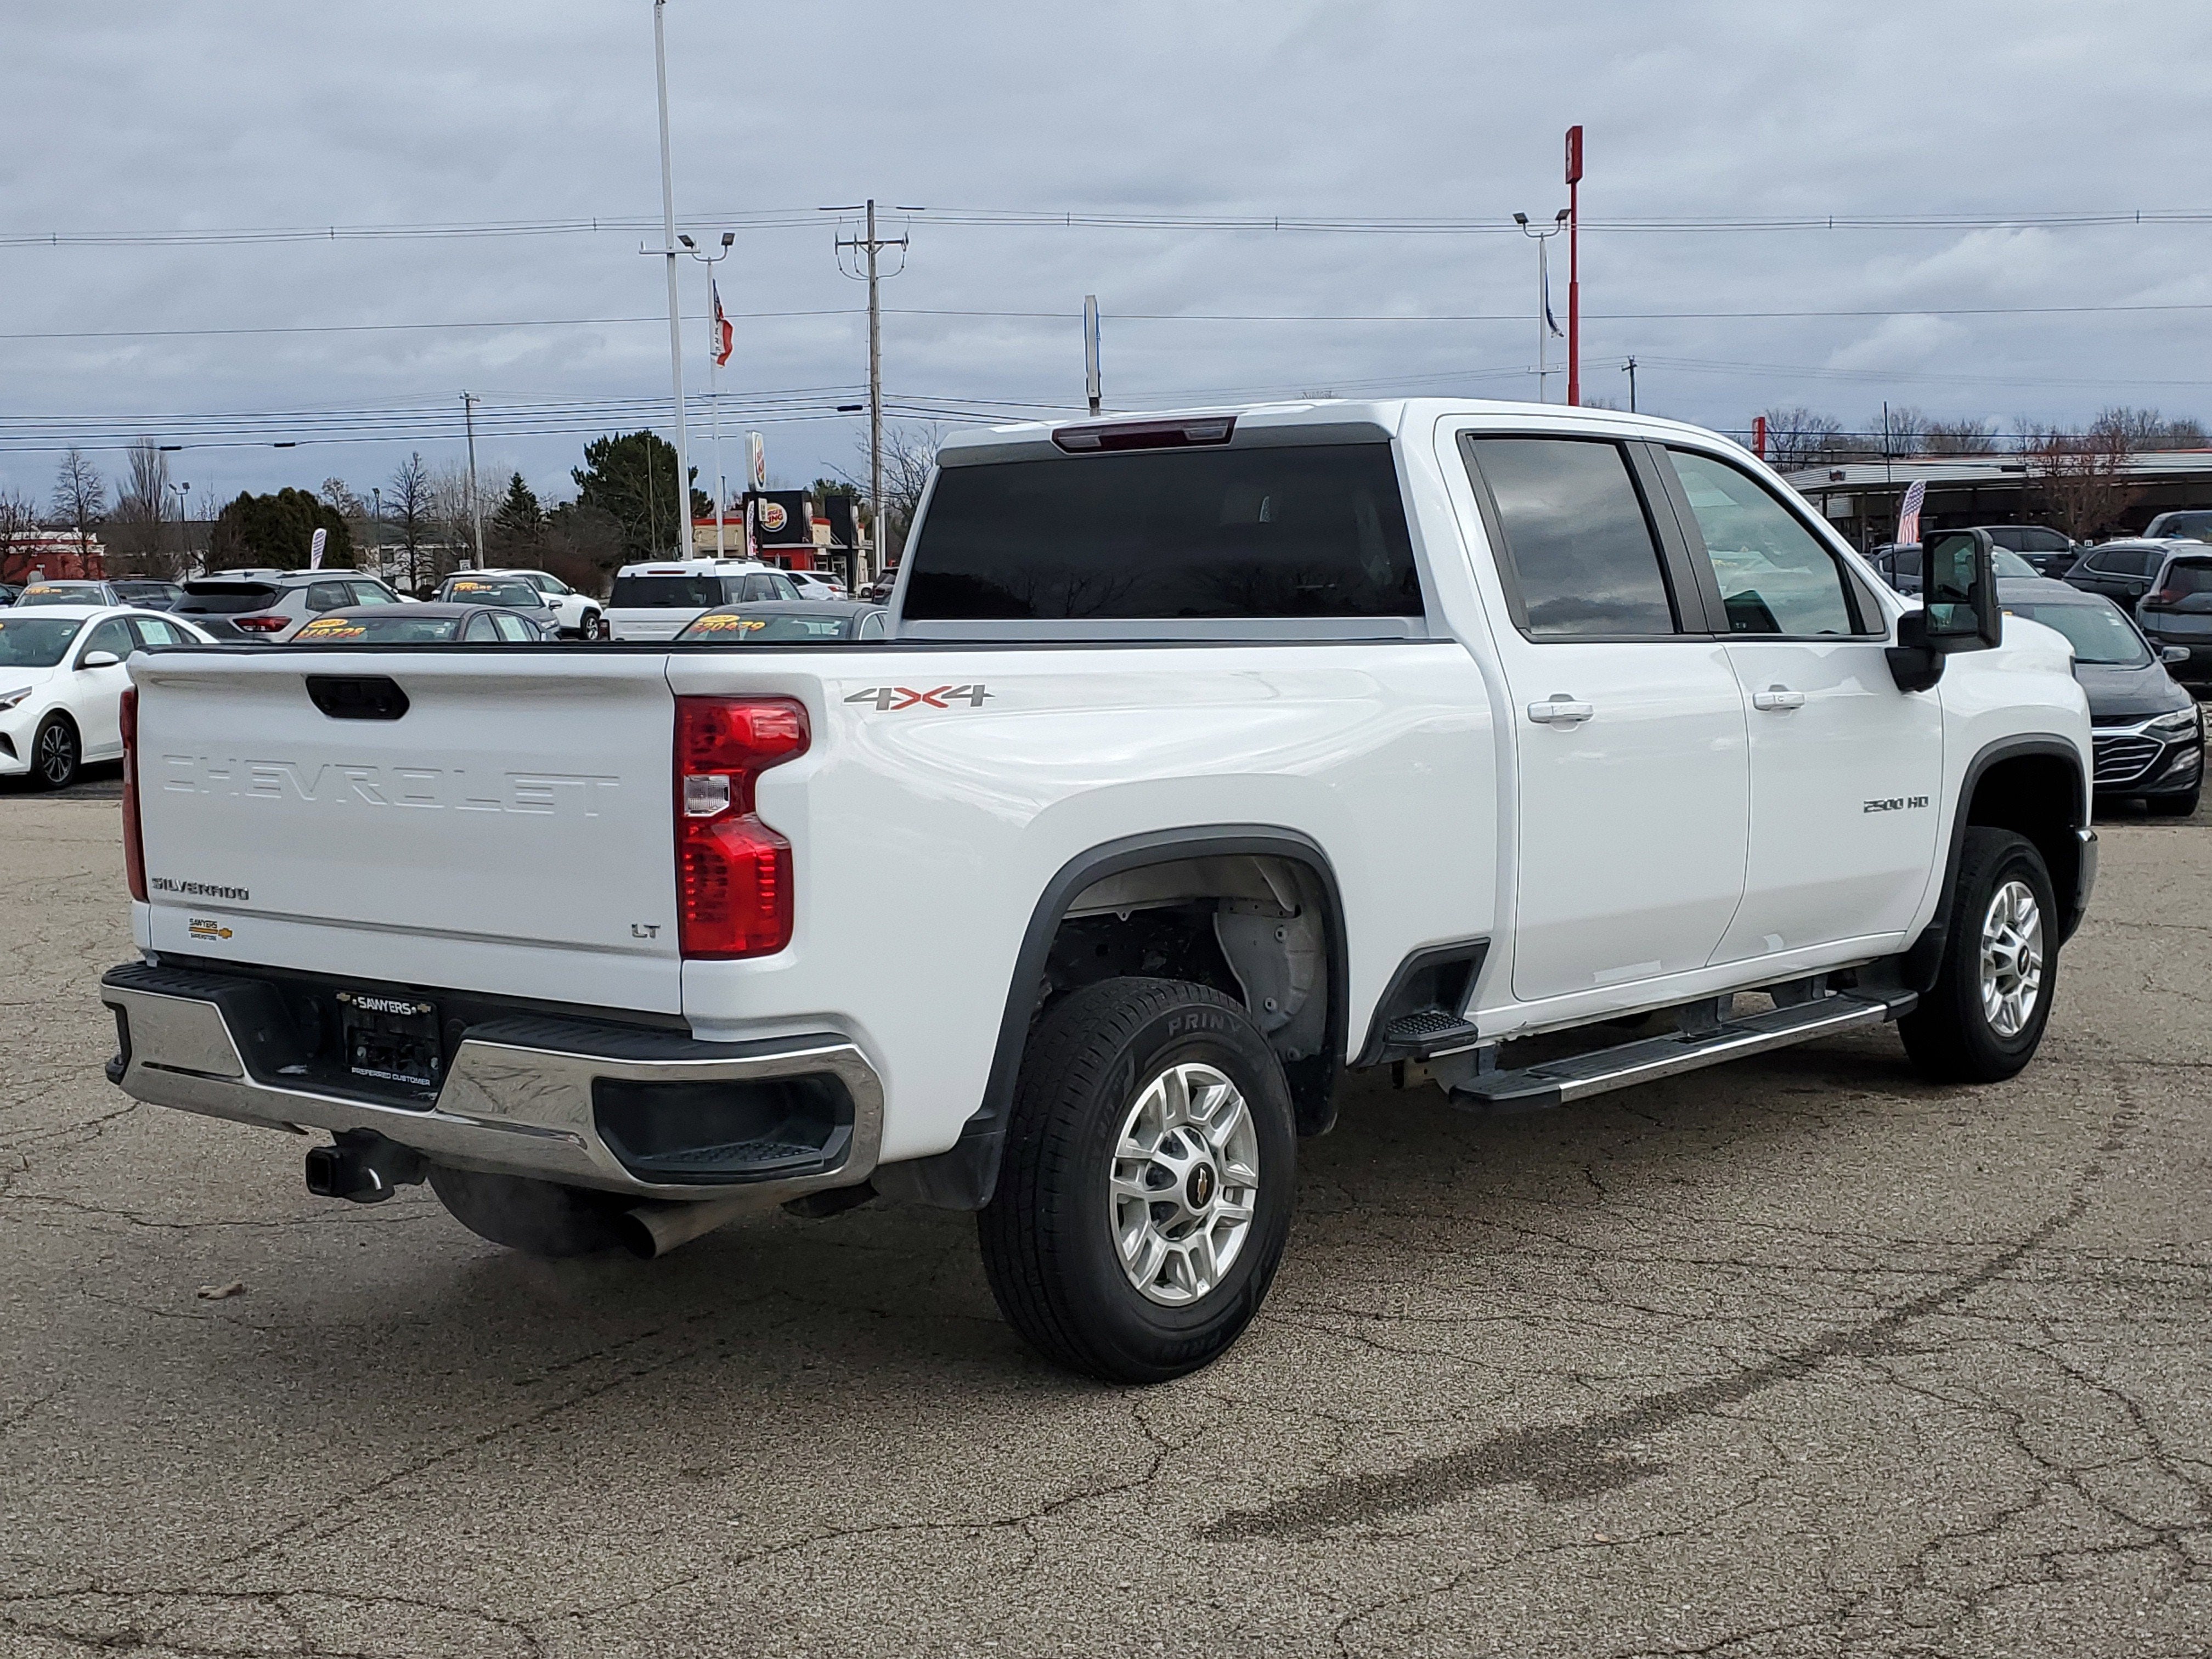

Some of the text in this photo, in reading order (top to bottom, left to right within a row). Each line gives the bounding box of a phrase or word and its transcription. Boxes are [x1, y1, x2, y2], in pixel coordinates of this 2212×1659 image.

[162, 754, 620, 816] CHEVROLET
[1864, 796, 1929, 813] 2500 HD
[151, 878, 250, 900] SILVERADO
[631, 923, 661, 939] LT
[357, 996, 411, 1015] SAWYERS
[352, 1066, 430, 1086] PREFERRED CUSTOMER
